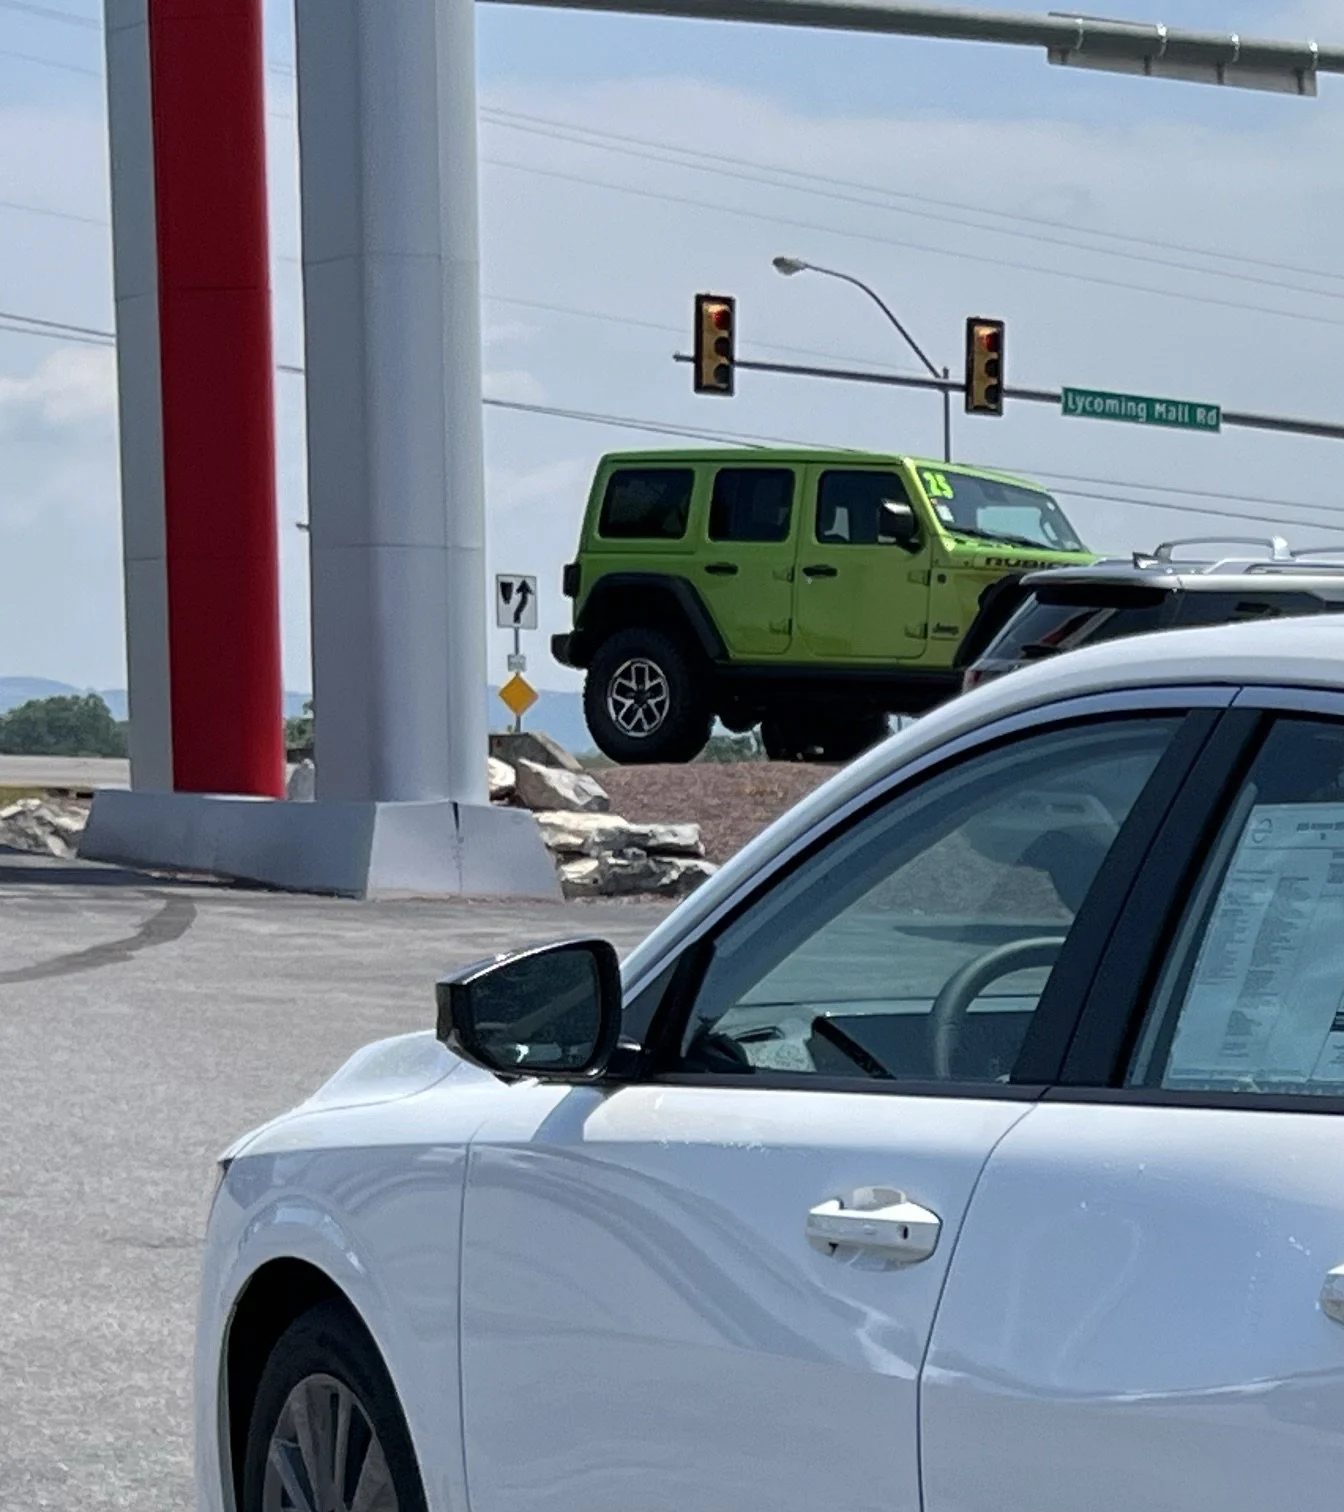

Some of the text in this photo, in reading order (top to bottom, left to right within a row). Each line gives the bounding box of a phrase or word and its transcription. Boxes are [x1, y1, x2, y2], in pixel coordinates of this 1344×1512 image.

[1067, 391, 1218, 426] Lycoming Mall Rd
